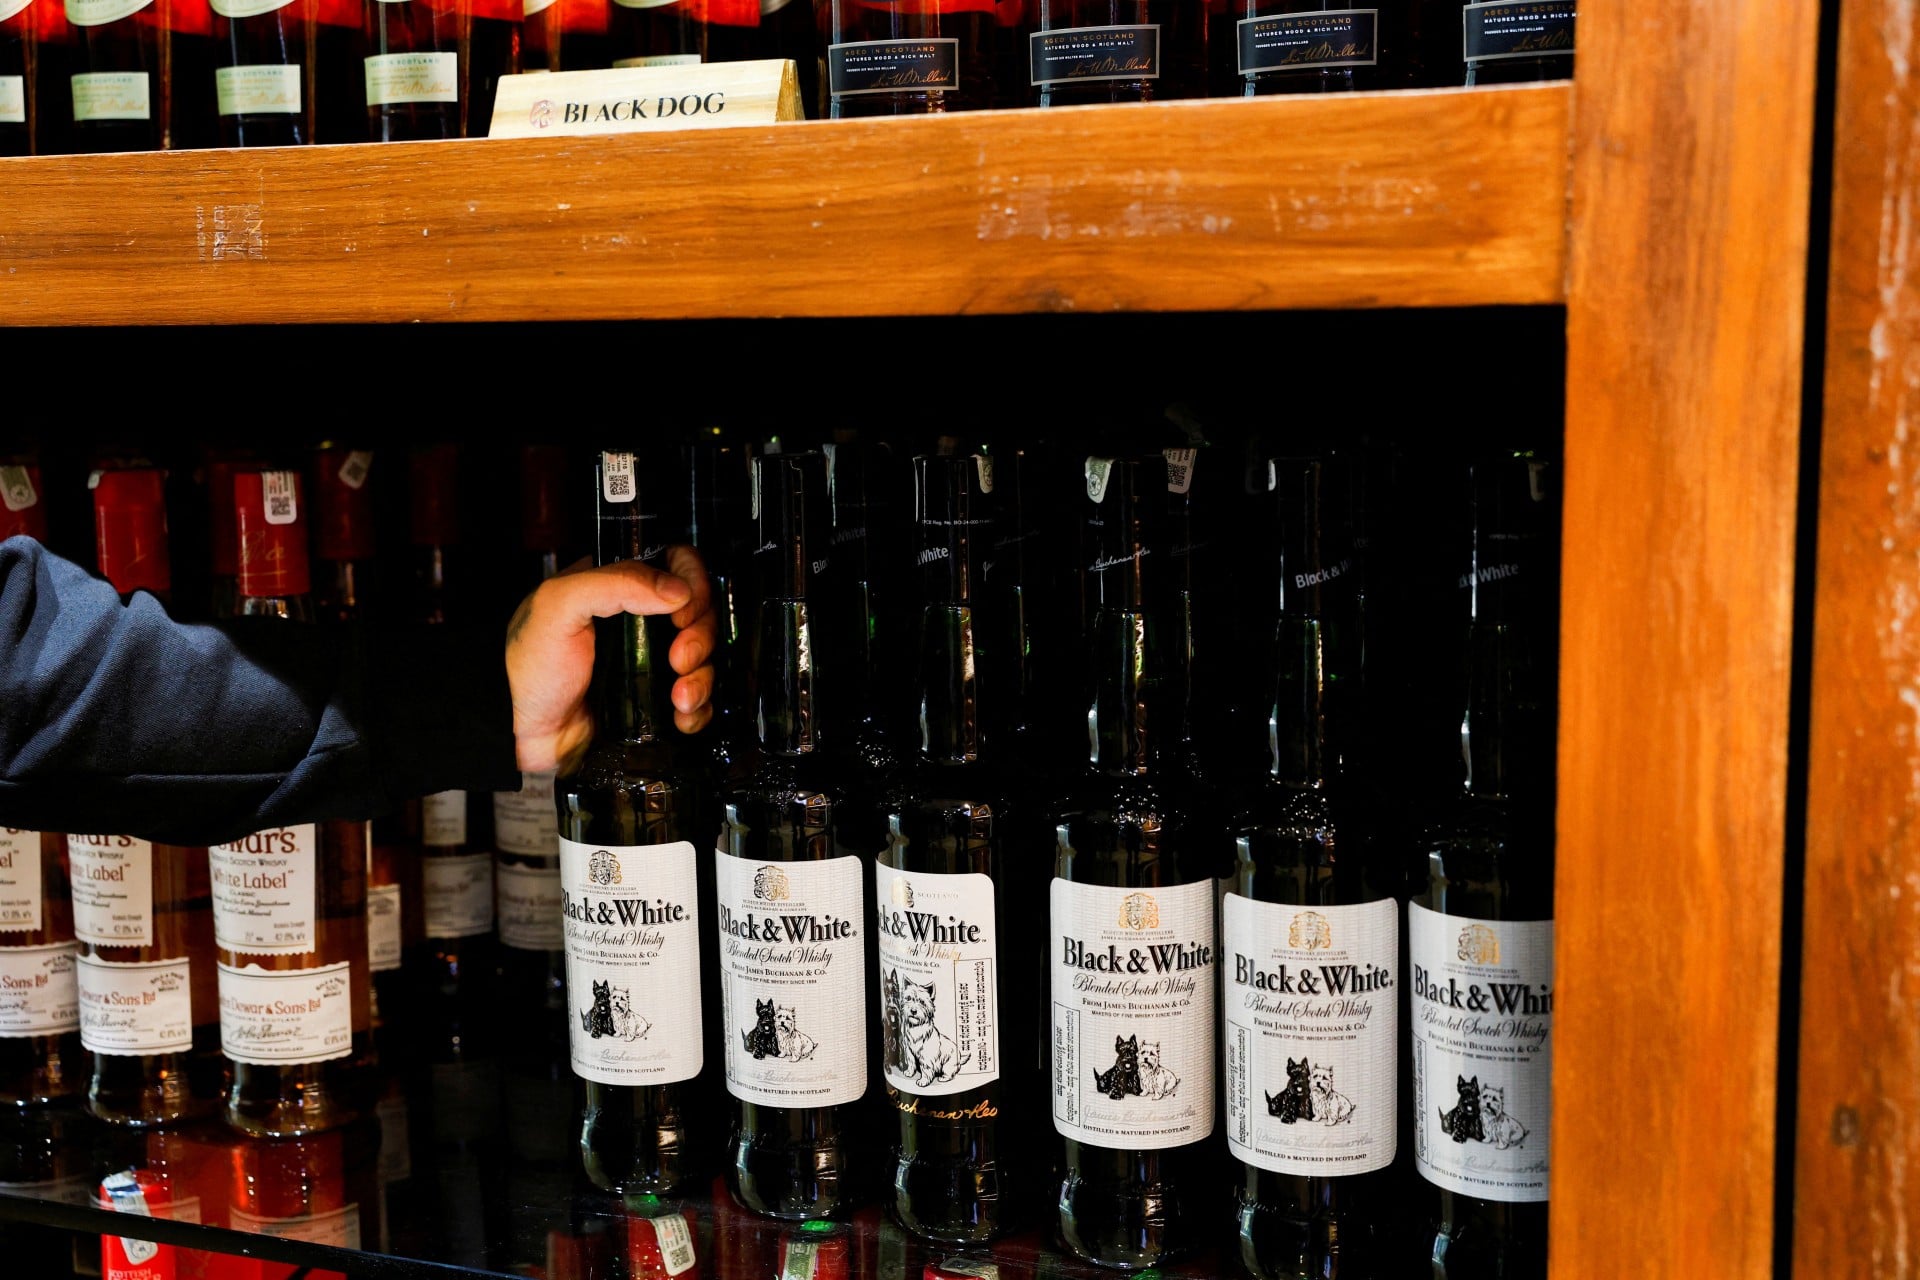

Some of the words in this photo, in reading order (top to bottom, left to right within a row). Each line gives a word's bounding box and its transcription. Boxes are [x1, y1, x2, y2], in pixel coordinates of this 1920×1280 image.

[1484, 8, 1510, 16] AGED
[1297, 17, 1351, 27] SCOTLAND
[1083, 33, 1134, 41] SCOTLAND
[564, 98, 648, 124] BLACK
[656, 92, 726, 118] DOG
[86, 863, 124, 881] Label
[244, 872, 287, 889] Label
[595, 929, 627, 947] Scotch
[626, 927, 665, 950] Whisky
[726, 938, 760, 960] Blended
[759, 947, 793, 966] Scotch
[793, 944, 833, 968] Whisky
[919, 943, 962, 960] Whisky
[3, 975, 33, 989] Sons
[1073, 973, 1122, 994] Blended
[1122, 978, 1158, 1000] Scotch
[1159, 973, 1196, 997] Whisky
[111, 991, 140, 1005] Sons
[1172, 1000, 1177, 1008] &
[274, 1000, 306, 1015] Sons
[1244, 992, 1294, 1015] Blended
[1294, 999, 1332, 1021] Scotch
[1332, 995, 1373, 1022] Whisky
[1345, 1023, 1352, 1031] &
[1420, 1004, 1462, 1031] Blended
[1462, 1017, 1502, 1040] Scotch
[1502, 1016, 1548, 1046] Whisky
[1083, 1125, 1114, 1134] DISTILLED
[1161, 1125, 1190, 1135] SCOTLAND
[1256, 1148, 1286, 1159] DISTILLED
[1335, 1154, 1367, 1162] SCOTLAND
[1464, 1176, 1495, 1186] MATURED
